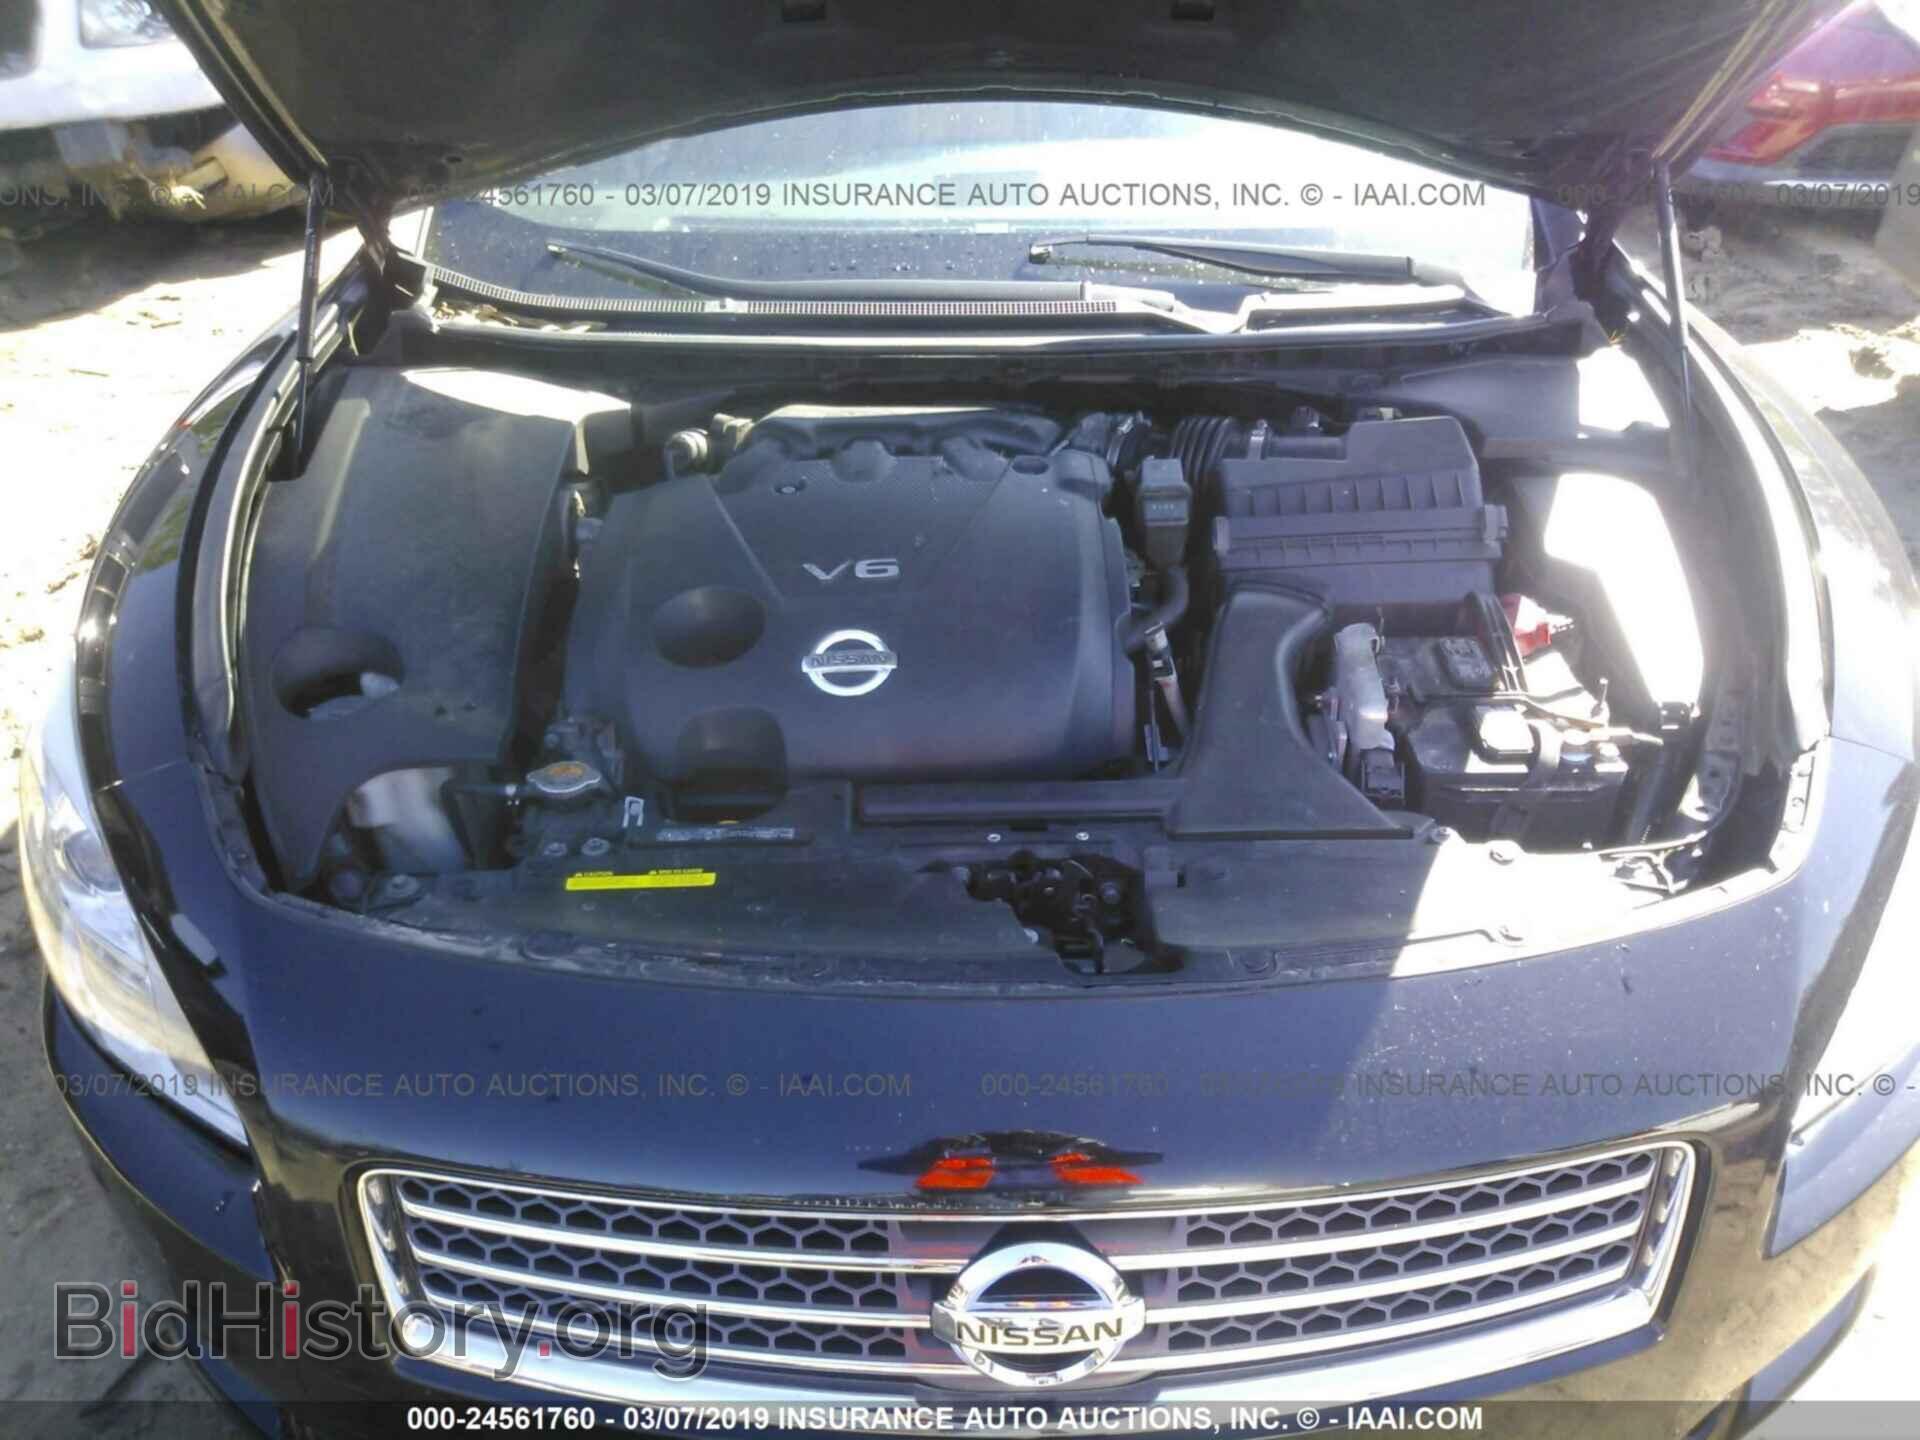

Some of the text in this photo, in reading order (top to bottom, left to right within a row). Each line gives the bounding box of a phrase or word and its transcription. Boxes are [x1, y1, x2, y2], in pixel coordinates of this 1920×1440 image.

[802, 558, 900, 580] V6
[810, 653, 889, 667] NISSAN
[955, 1318, 1124, 1347] NISSAN
